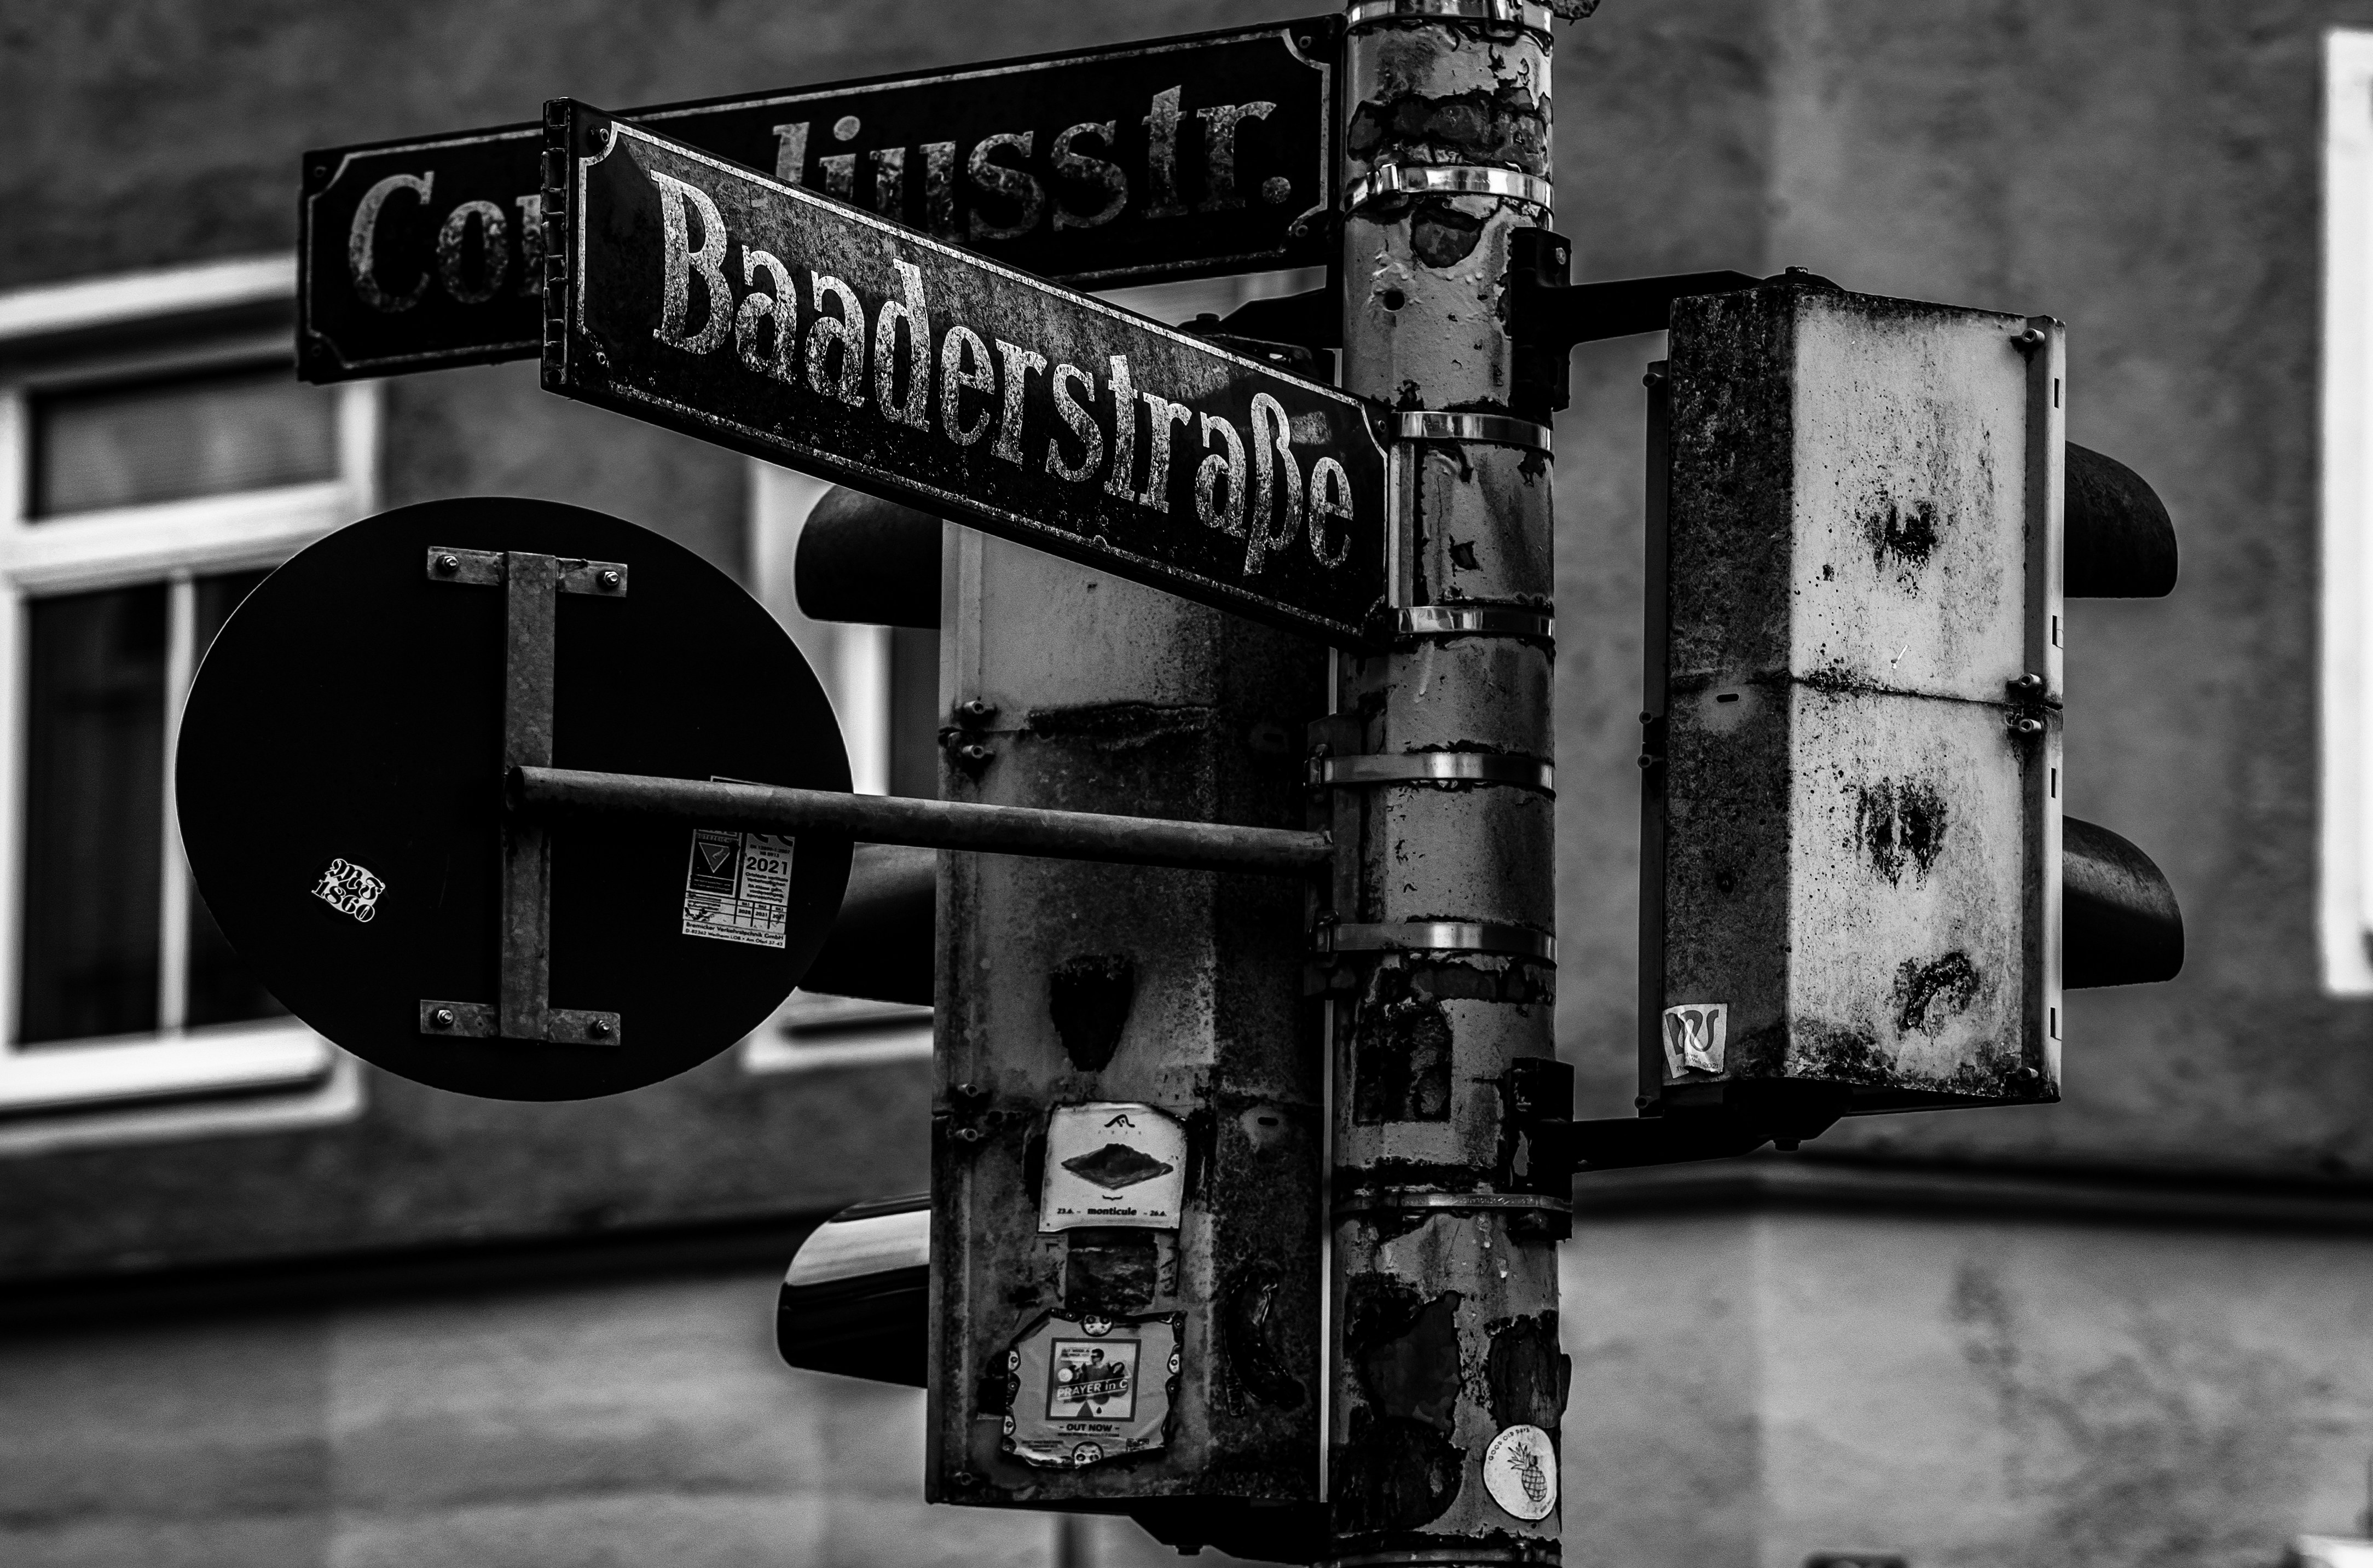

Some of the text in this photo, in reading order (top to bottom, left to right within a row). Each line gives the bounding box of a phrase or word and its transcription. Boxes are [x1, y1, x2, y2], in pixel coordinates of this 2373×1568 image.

[650, 170, 1353, 576] Baaderstraße
[746, 857, 788, 875] 2021
[311, 880, 375, 922] 1860
[686, 922, 715, 930] Bremicker
[1087, 1207, 1137, 1216] monticule
[1057, 1379, 1128, 1398] PRAYER in C
[1066, 1423, 1113, 1432] OUT NOW
[1489, 1440, 1502, 1461] GOOD
